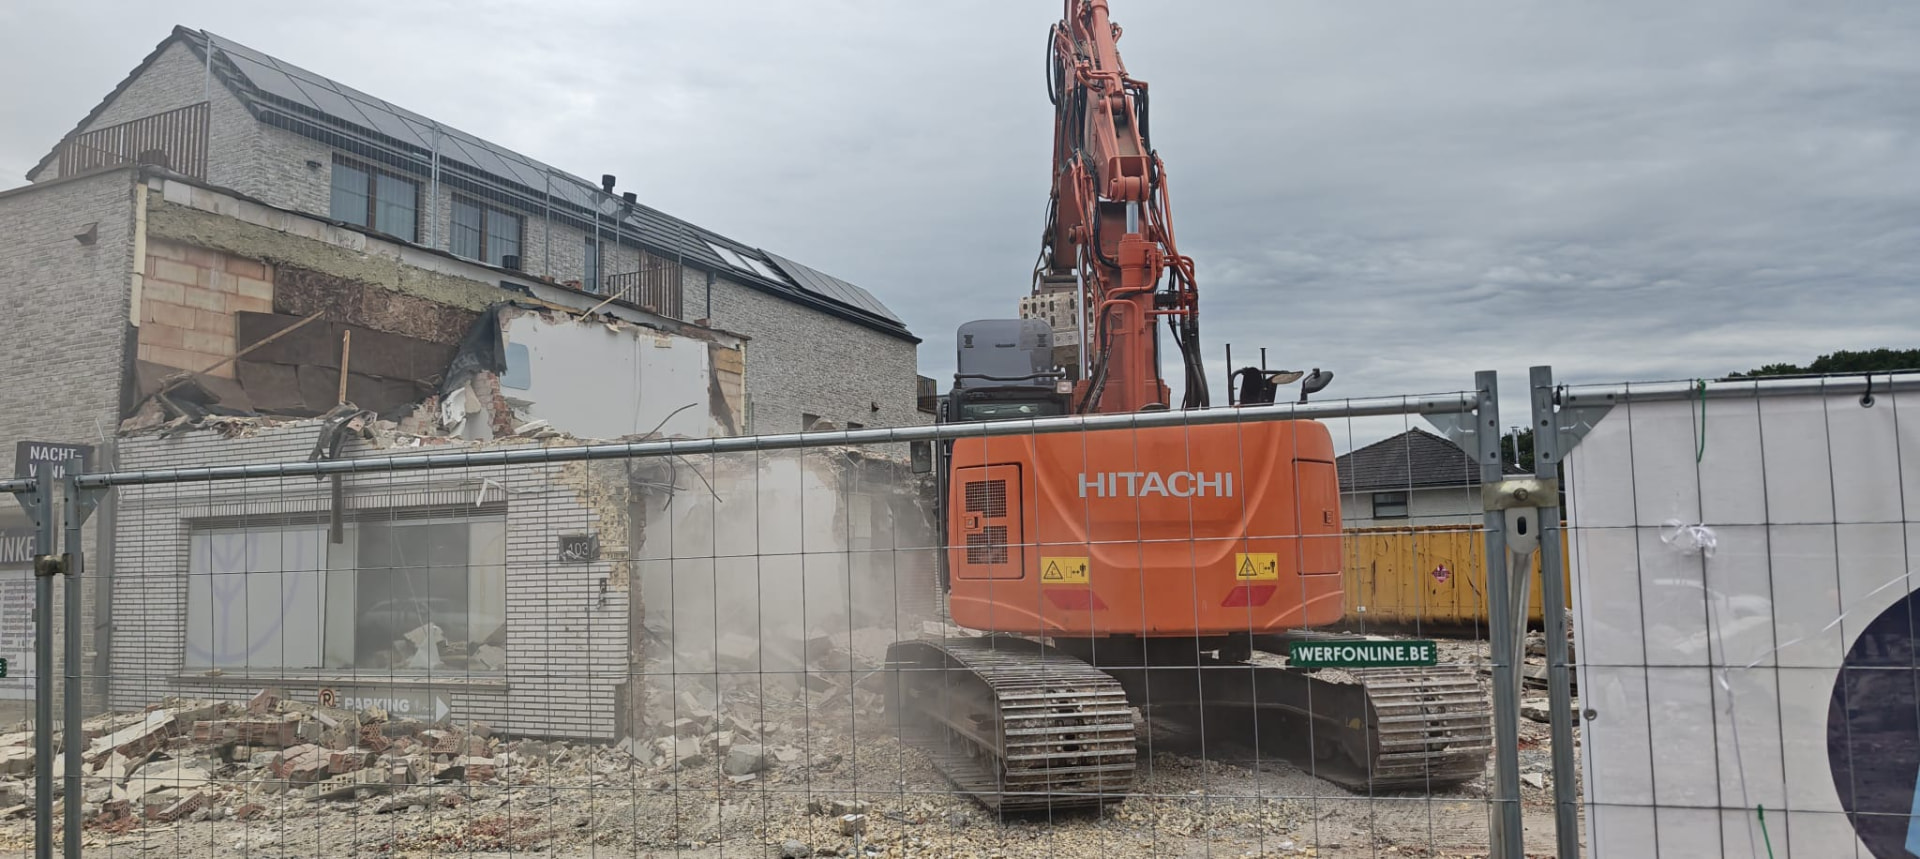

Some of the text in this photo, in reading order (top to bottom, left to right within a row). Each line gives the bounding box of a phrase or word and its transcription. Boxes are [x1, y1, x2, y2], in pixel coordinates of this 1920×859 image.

[1079, 471, 1233, 498] HITACHI
[567, 542, 589, 557] 103
[344, 697, 411, 713] PARKING
